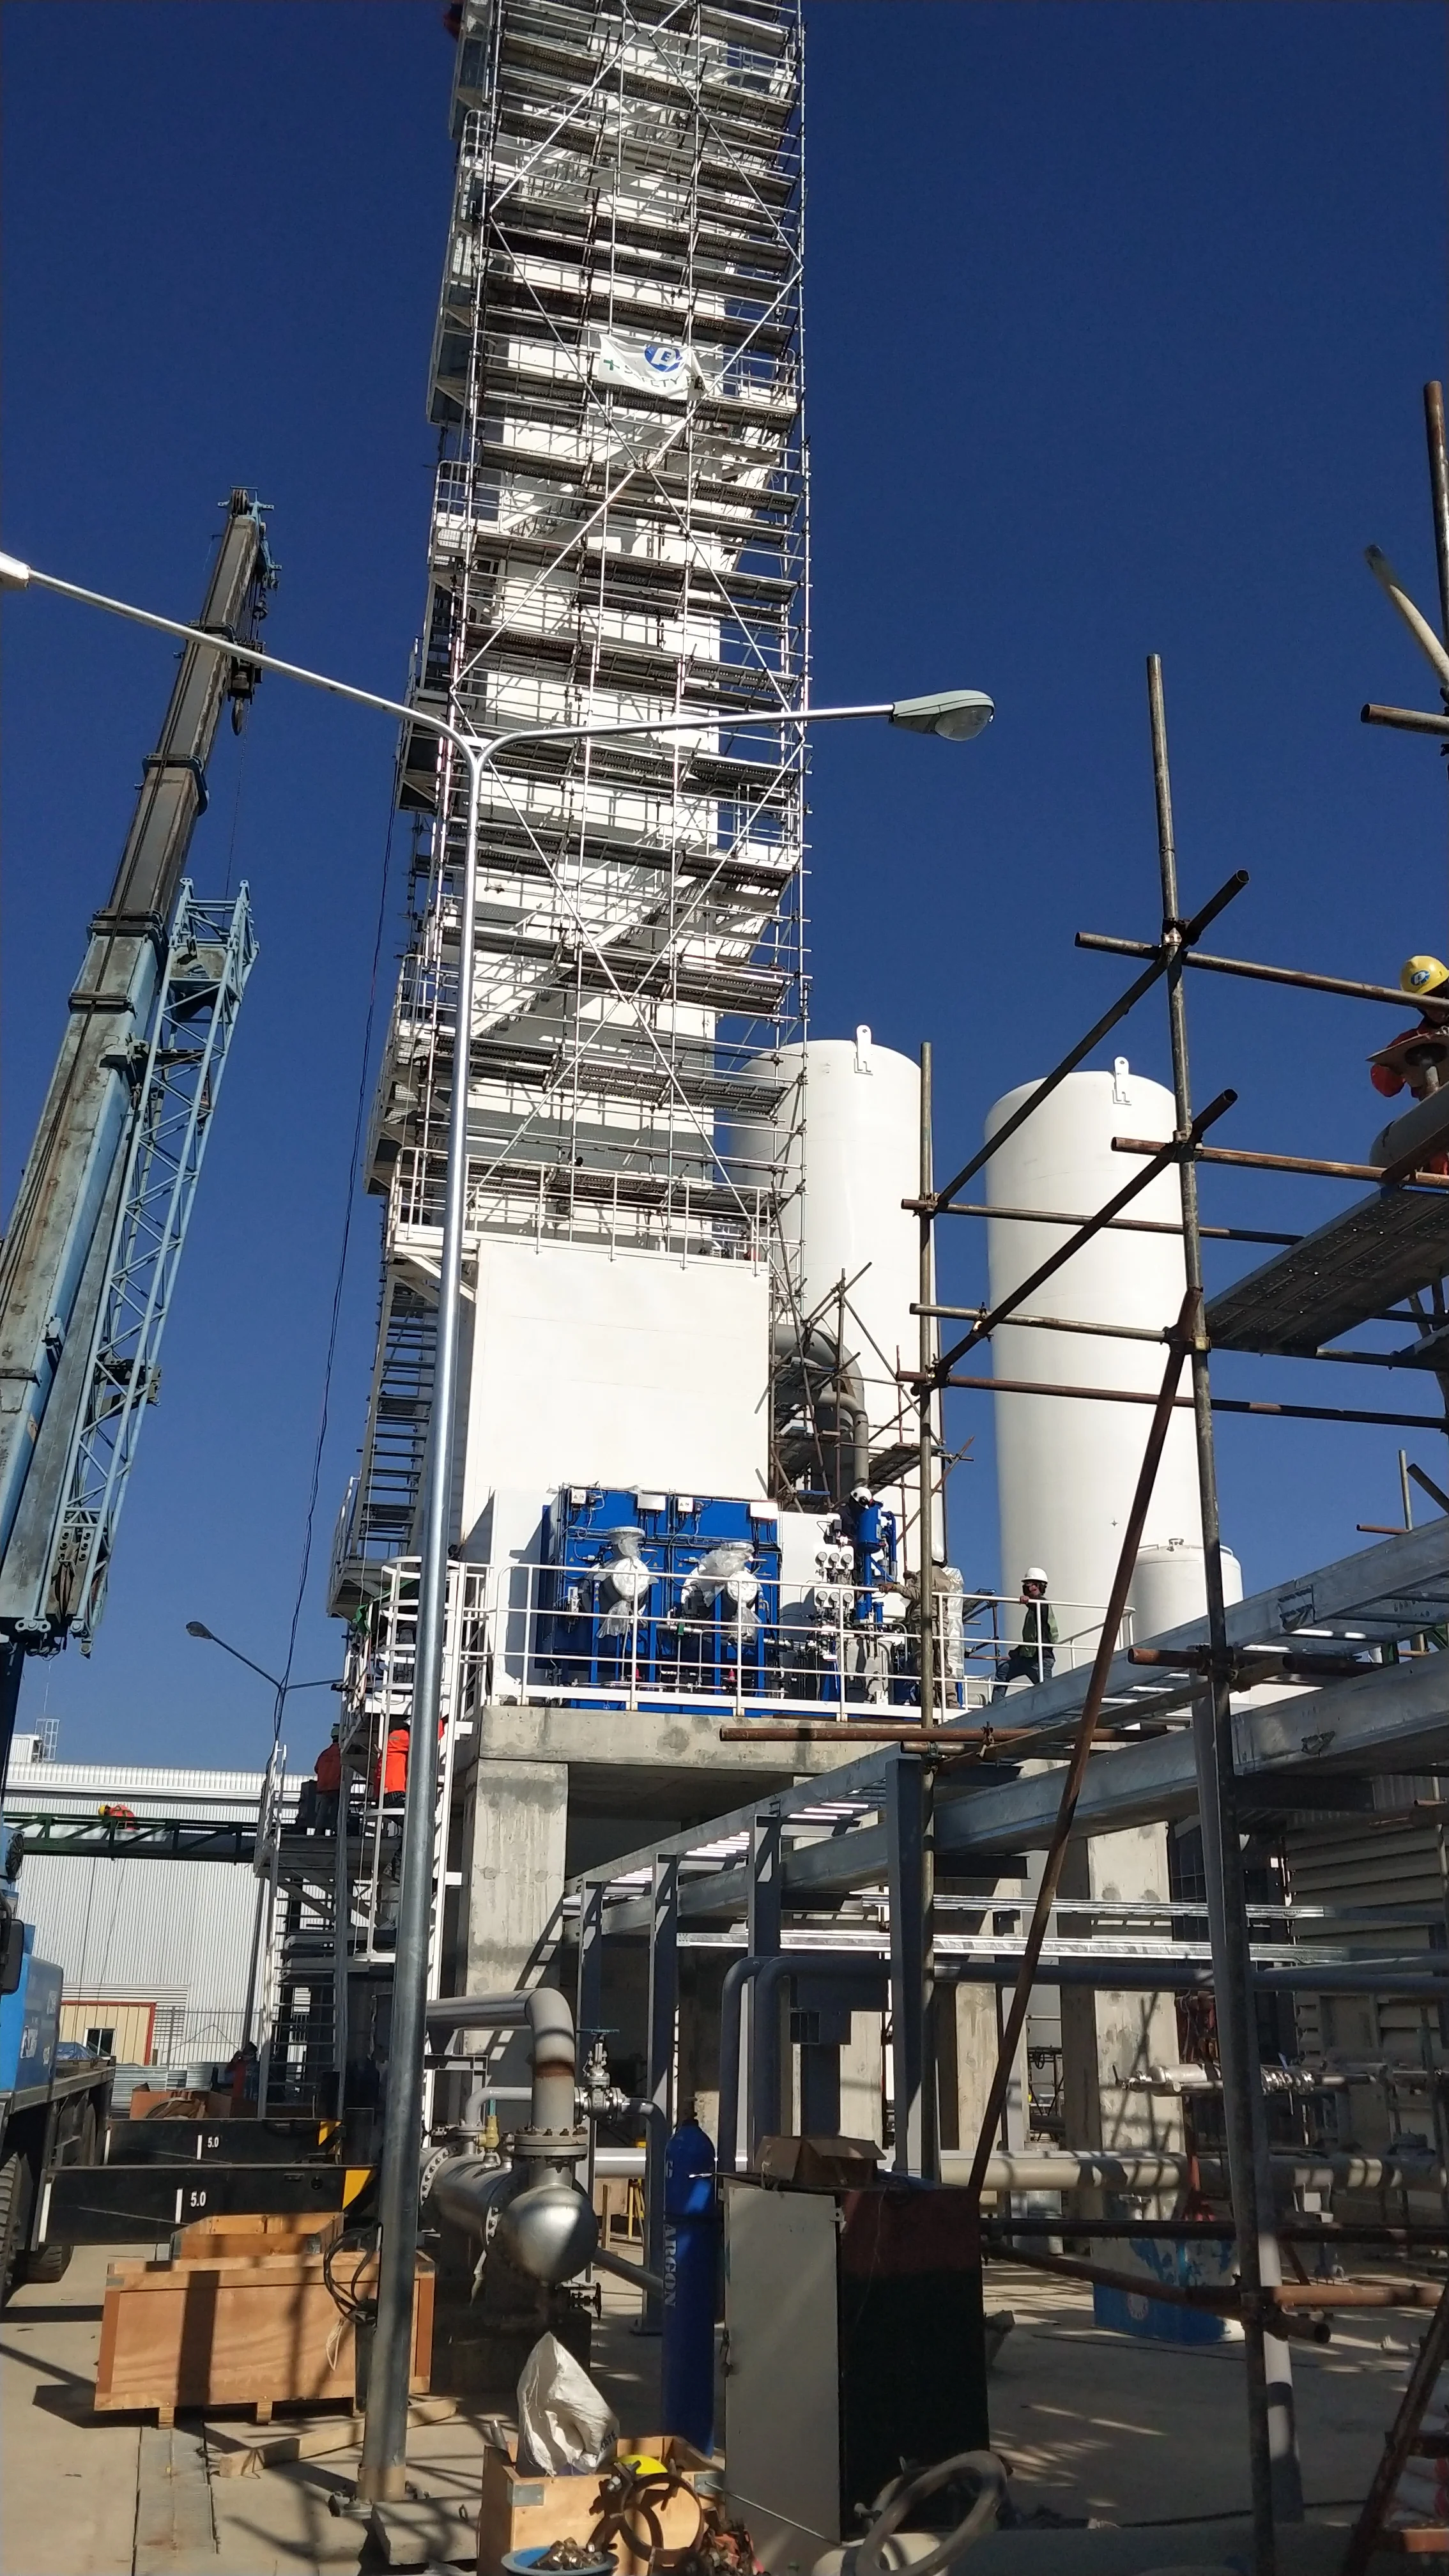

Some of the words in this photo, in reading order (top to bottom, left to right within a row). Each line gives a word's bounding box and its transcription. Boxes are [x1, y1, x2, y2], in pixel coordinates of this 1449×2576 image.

[207, 2136, 219, 2148] 5.0
[190, 2191, 206, 2207] 5.0
[664, 2224, 677, 2308] ARGON
